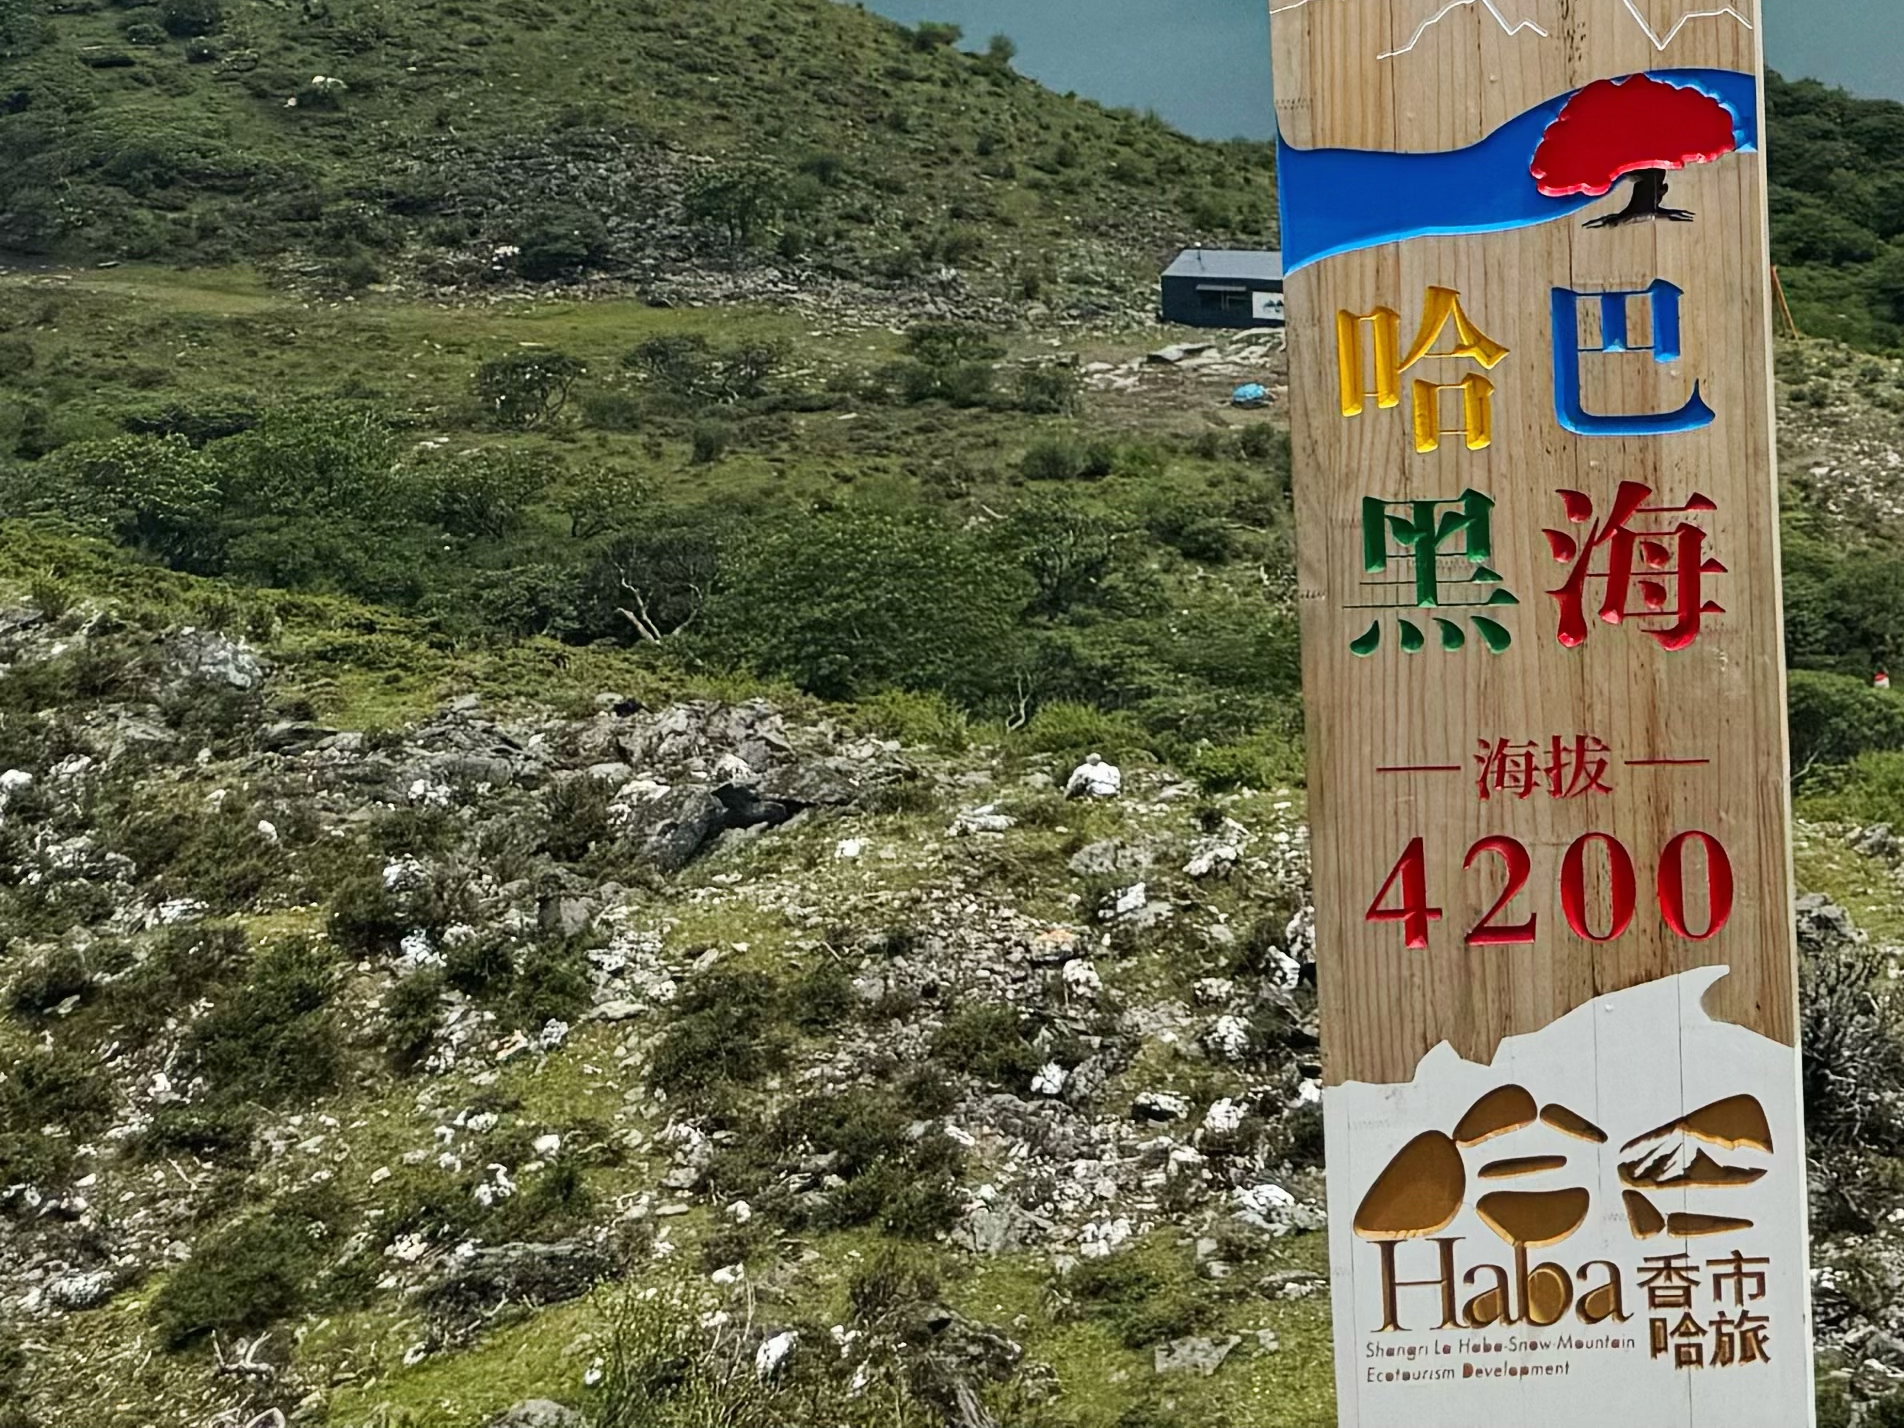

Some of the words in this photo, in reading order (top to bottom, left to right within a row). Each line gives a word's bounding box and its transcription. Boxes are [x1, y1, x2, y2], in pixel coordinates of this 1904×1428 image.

[1337, 278, 1716, 453] 哈巴
[1342, 481, 1728, 655] 黑海
[1473, 735, 1614, 799] 海拔
[1365, 831, 1735, 949] 4200
[1367, 1237, 1634, 1332] Haba
[1366, 1340, 1428, 1360] Shangri
[1434, 1340, 1451, 1355] La
[1367, 1366, 1455, 1383] Ecotourism
[1463, 1360, 1570, 1380] Development
